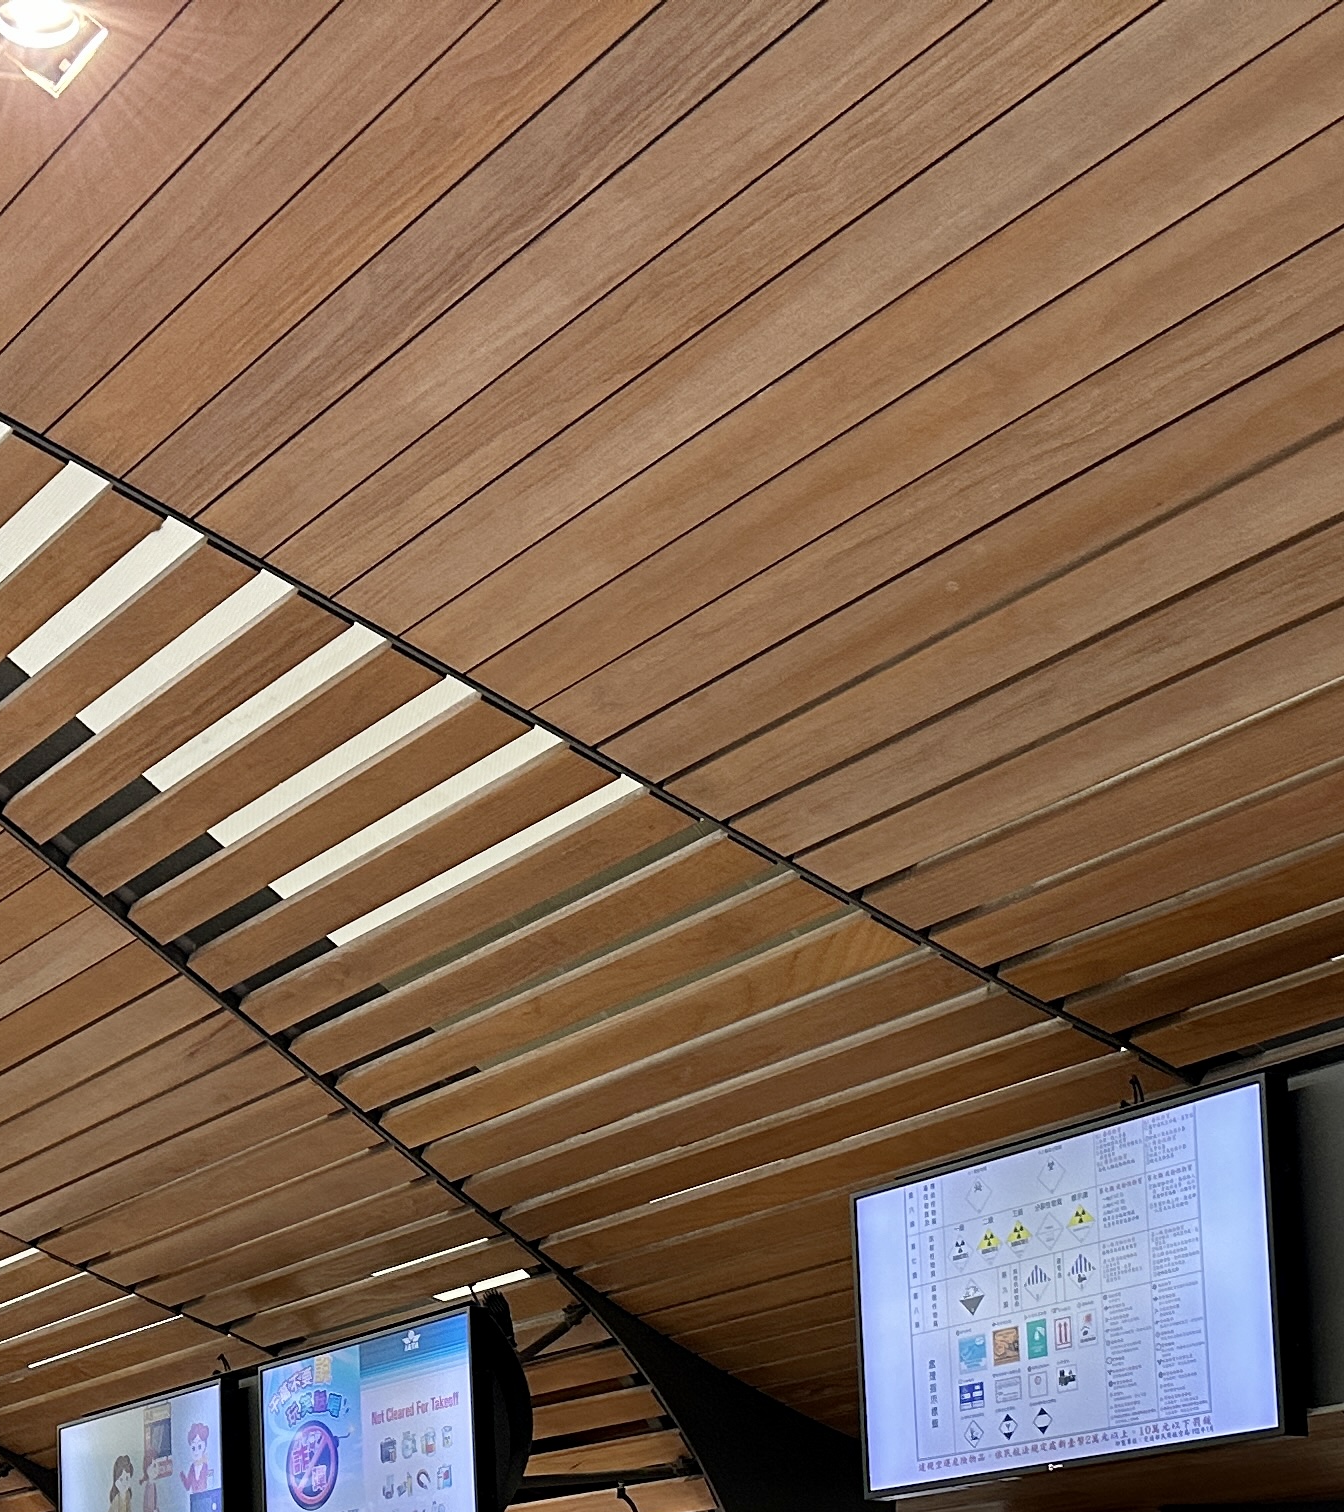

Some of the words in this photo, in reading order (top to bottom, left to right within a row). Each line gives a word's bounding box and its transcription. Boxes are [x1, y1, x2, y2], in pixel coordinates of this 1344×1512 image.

[371, 1411, 384, 1426] Not
[385, 1404, 415, 1422] Cleared
[416, 1400, 429, 1415] For
[431, 1391, 459, 1411] Takeoff
